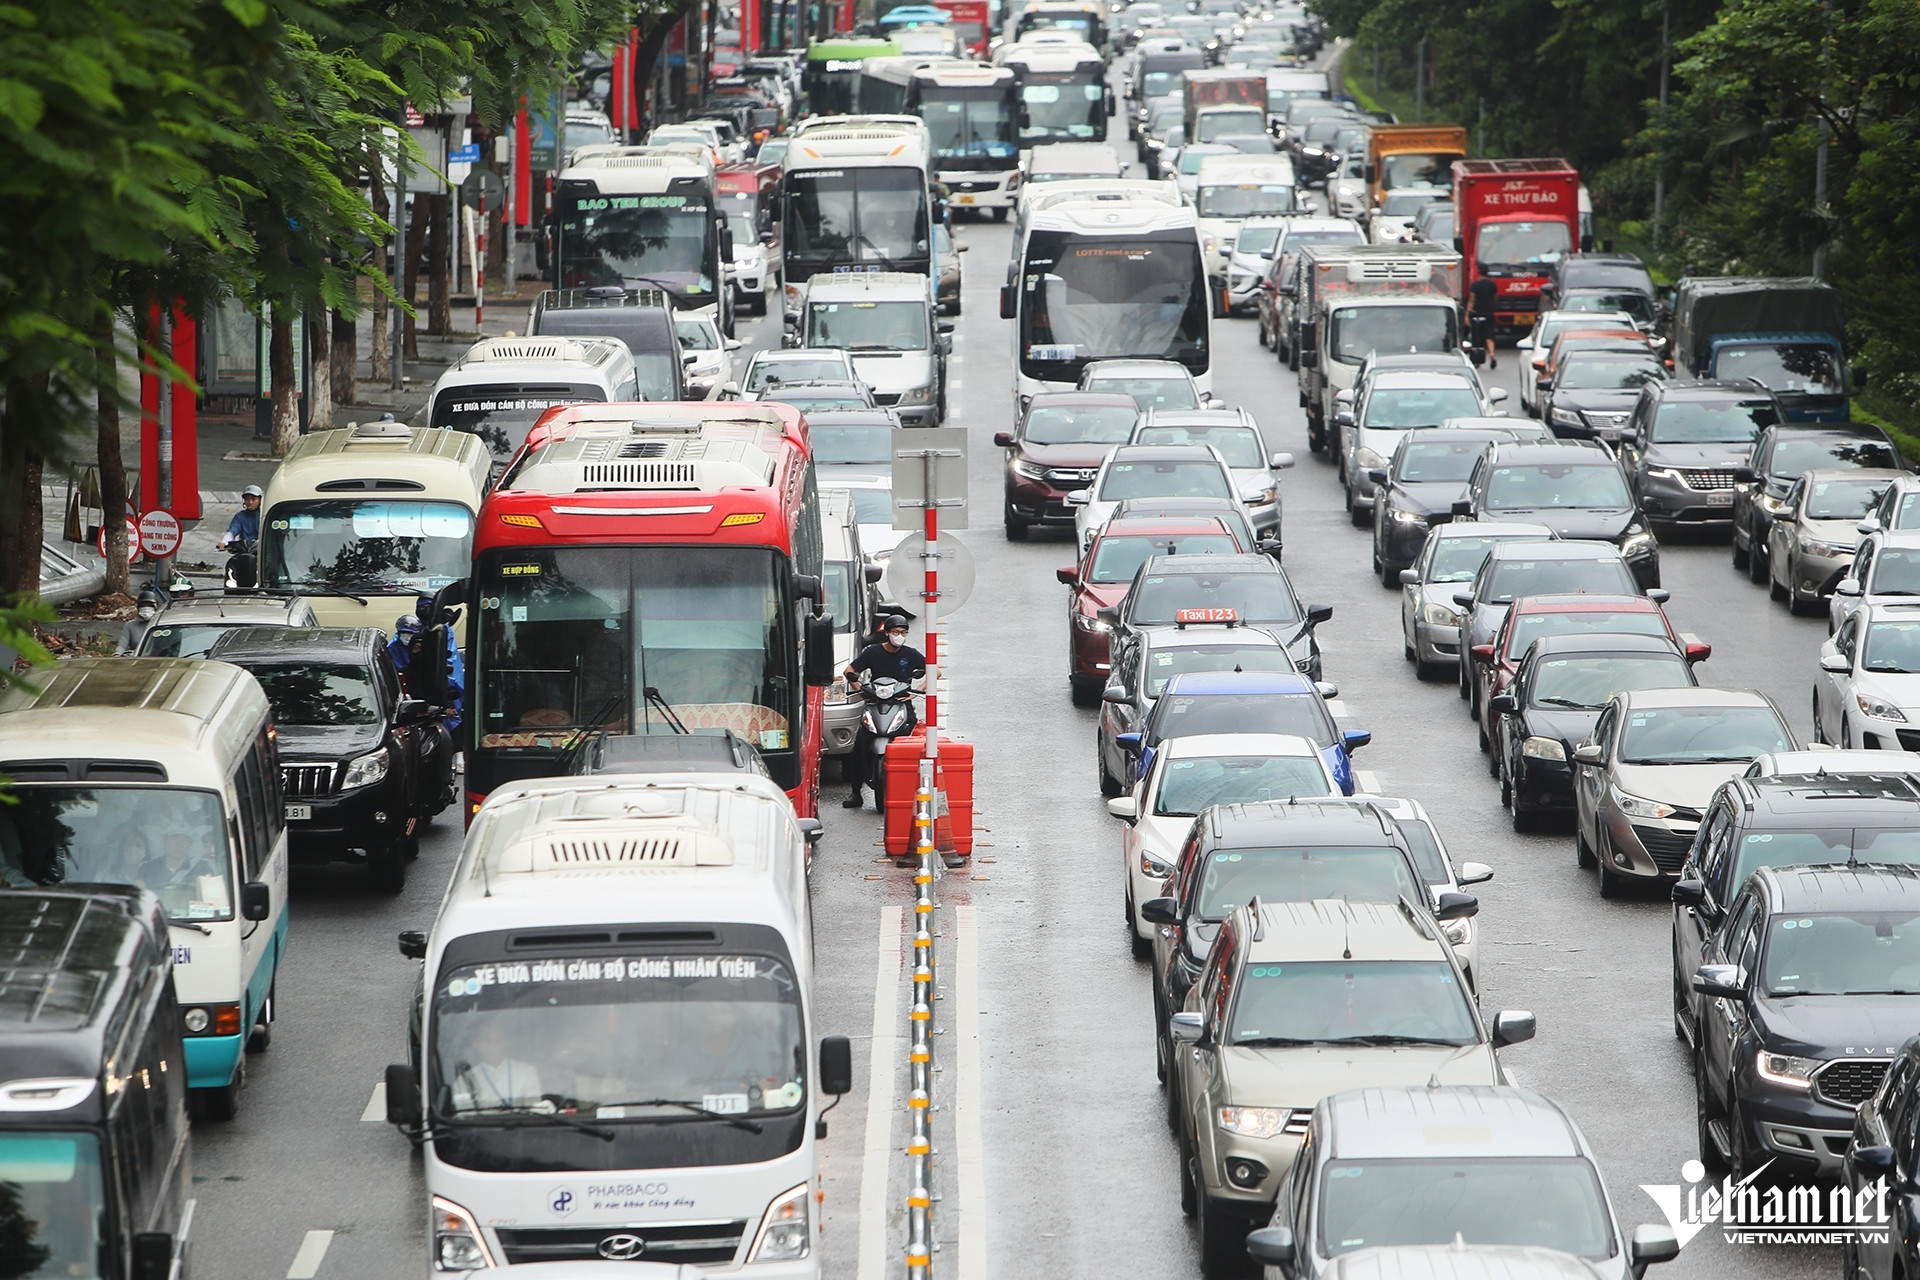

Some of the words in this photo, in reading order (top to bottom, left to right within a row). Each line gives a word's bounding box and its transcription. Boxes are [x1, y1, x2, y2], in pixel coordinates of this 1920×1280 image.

[1484, 193, 1500, 204] XE
[1503, 192, 1531, 204] THƯ
[1532, 189, 1558, 203] BÁO
[577, 199, 608, 211] BAO
[610, 197, 639, 208] YEN
[640, 196, 687, 207] GROUP
[1075, 249, 1105, 257] LOTTE
[453, 403, 463, 412] XE
[464, 403, 479, 411] ĐƯA
[481, 401, 496, 410] ĐÓN
[498, 400, 514, 410] CÁN
[515, 400, 526, 411] BỘ
[527, 400, 548, 409] CÔNG
[142, 519, 156, 527] CÔNG
[164, 532, 177, 541] CÔNG
[502, 567, 511, 575] XE
[1181, 609, 1205, 620] Taxi
[1208, 609, 1234, 620] 123
[475, 967, 496, 985] XE
[497, 965, 530, 984] ĐƯA
[532, 962, 566, 981] ĐÓN
[568, 960, 600, 980] CÁN
[604, 958, 626, 982] BỘ
[628, 958, 670, 978] CÔNG
[674, 957, 717, 978] NHÂN
[720, 957, 756, 978] VIÊN
[587, 1183, 669, 1197] PHARBACO
